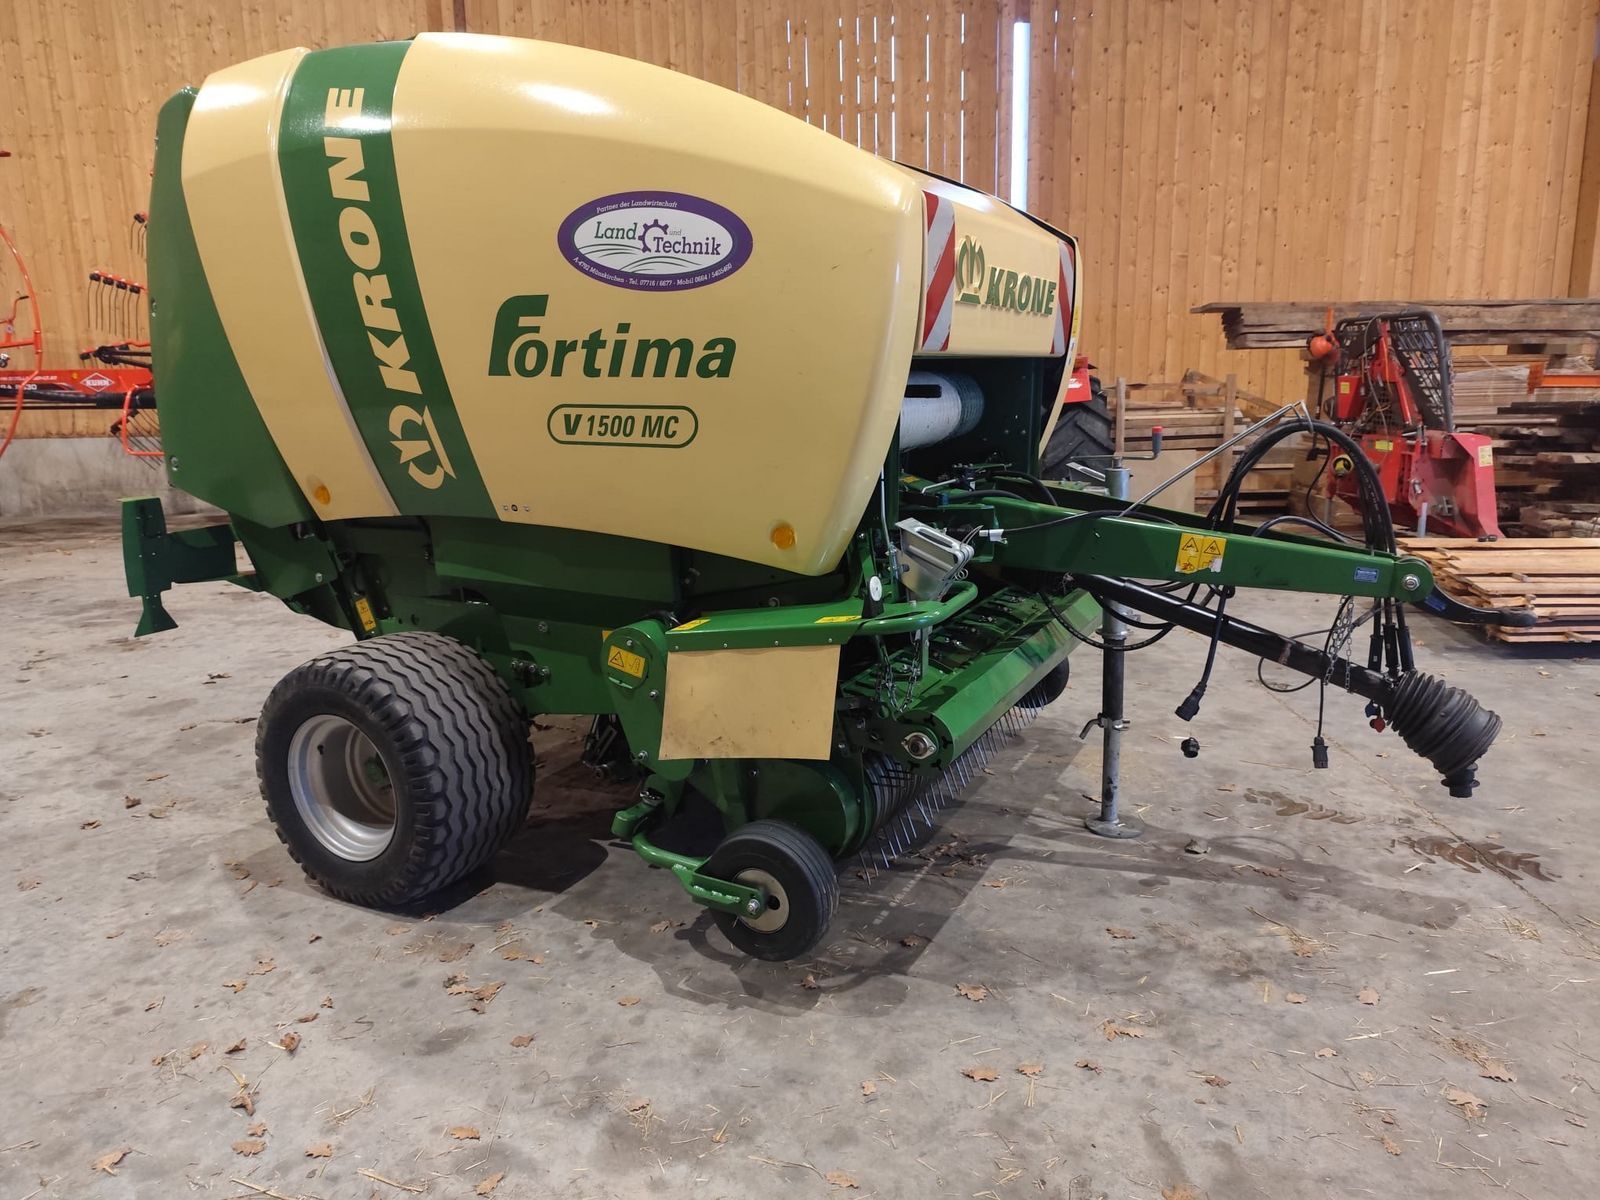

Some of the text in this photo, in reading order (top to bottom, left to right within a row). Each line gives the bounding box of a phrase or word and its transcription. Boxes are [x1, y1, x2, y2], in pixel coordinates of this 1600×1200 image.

[596, 200, 678, 214] Partner der Landwirtschaft
[323, 87, 423, 395] KRONE
[594, 221, 638, 240] Land
[653, 236, 721, 255] Technik
[676, 278, 694, 286] Mobil
[985, 267, 1057, 315] KRONE
[488, 294, 737, 378] Fortima
[563, 413, 680, 439] V 1500 MC
